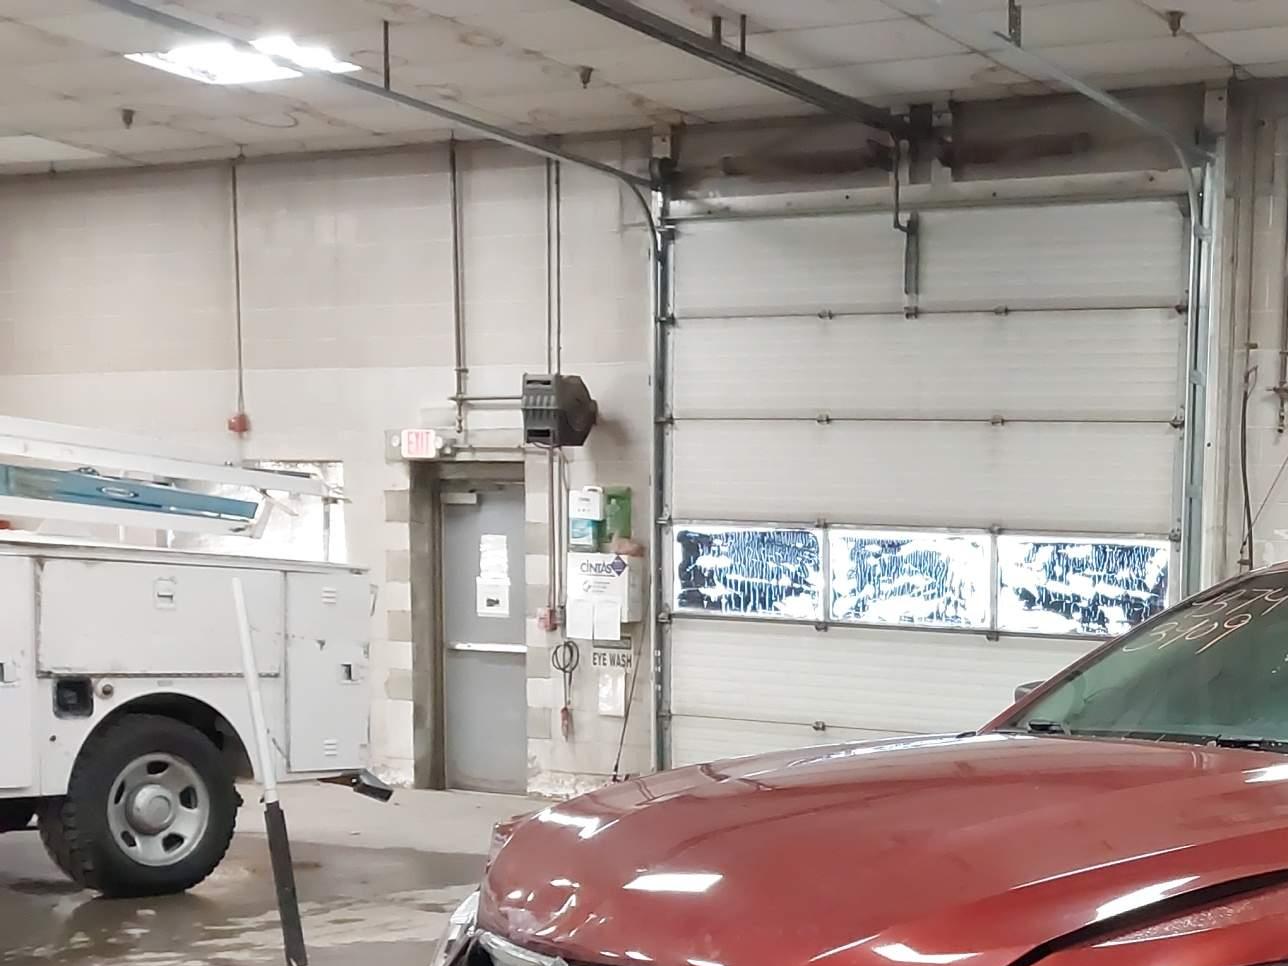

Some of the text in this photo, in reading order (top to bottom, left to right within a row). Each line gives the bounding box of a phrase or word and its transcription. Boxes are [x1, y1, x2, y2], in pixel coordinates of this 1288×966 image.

[407, 431, 431, 455] EXIT
[1122, 613, 1252, 655] 3409
[592, 652, 632, 668] EYE WASH
